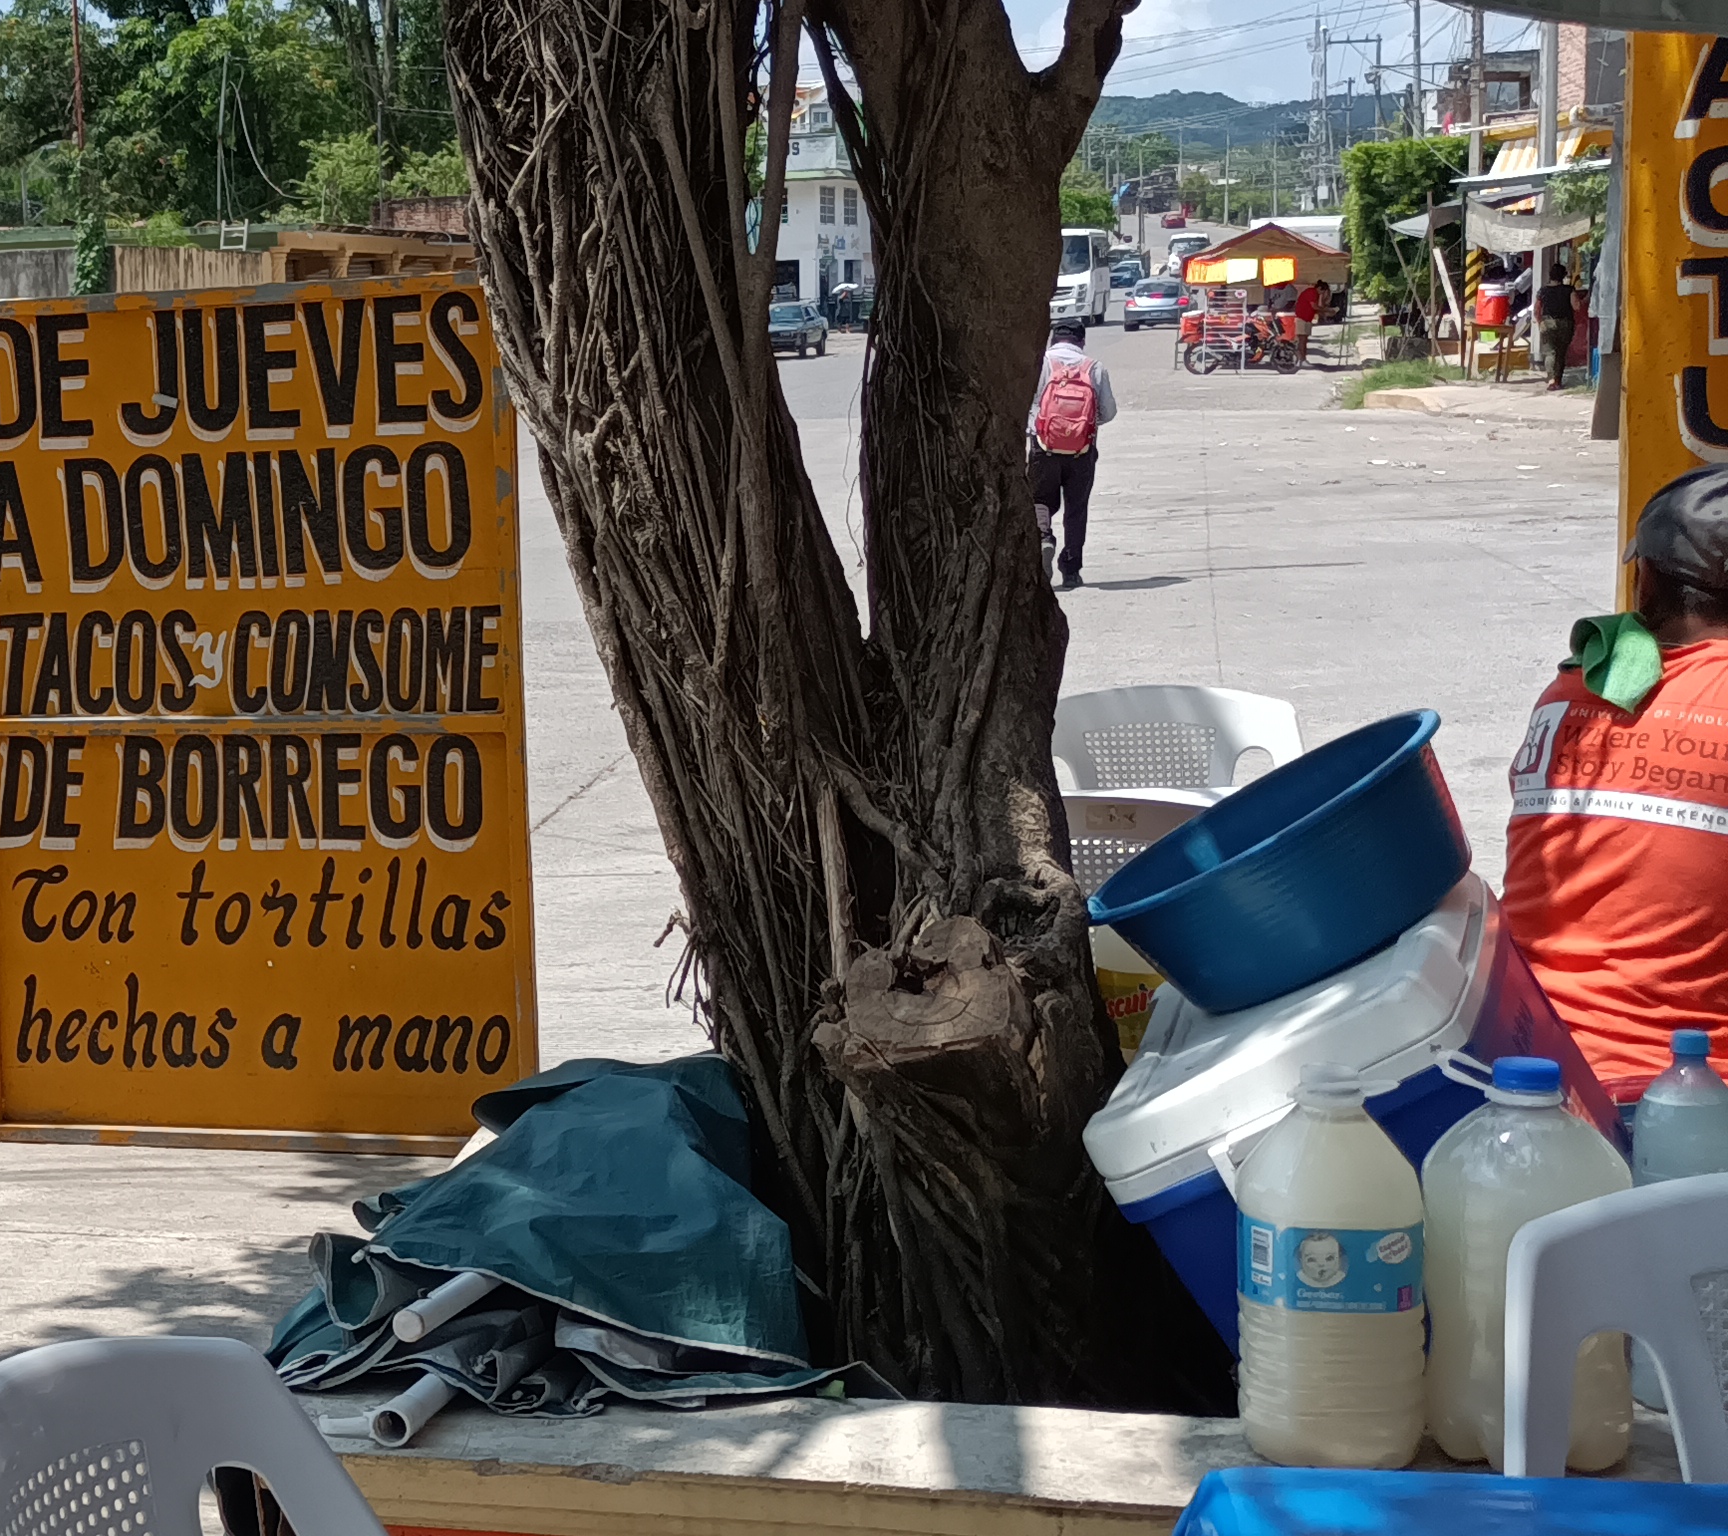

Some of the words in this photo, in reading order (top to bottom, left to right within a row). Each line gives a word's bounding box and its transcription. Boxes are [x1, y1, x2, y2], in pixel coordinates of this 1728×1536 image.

[120, 291, 483, 446] JUEVES
[57, 441, 471, 593] DOMINGO
[228, 604, 504, 716] CONSOME
[1564, 725, 1650, 749] Where
[1654, 710, 1671, 720] OF
[114, 733, 483, 852] BORREGO
[1554, 754, 1622, 783] Story
[1630, 757, 1728, 793] Began
[1587, 797, 1635, 811] FAMILY
[1642, 802, 1728, 826] WEEKEND
[176, 856, 508, 951] tortillas
[16, 971, 237, 1069] hechas
[261, 1013, 301, 1071] a
[333, 1011, 511, 1075] mano
[1106, 983, 1156, 1020] scui
